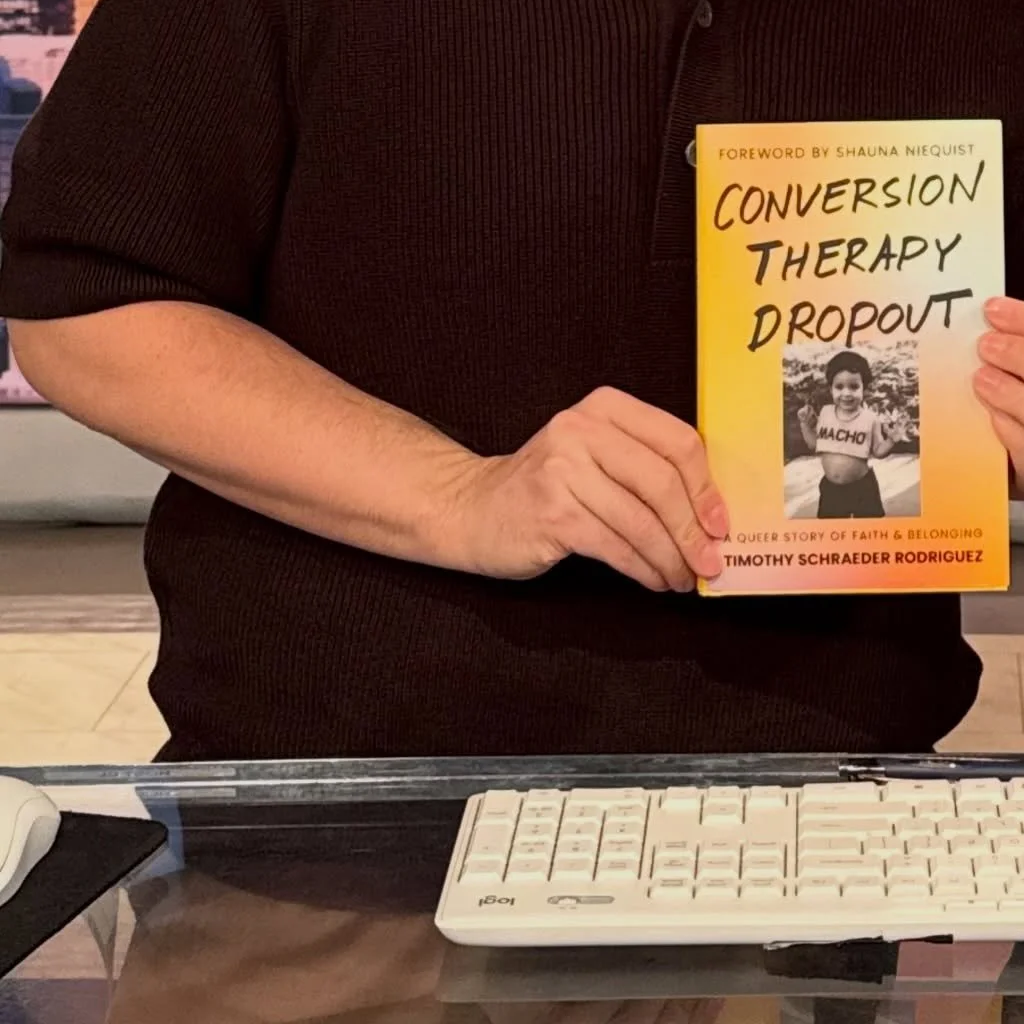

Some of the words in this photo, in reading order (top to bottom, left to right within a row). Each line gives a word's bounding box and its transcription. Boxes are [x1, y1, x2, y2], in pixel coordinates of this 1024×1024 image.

[718, 147, 805, 161] FOREWORD
[811, 146, 830, 159] BY
[835, 145, 899, 158] SHAUNA
[905, 144, 975, 158] NIEQUIST
[713, 159, 985, 231] CONVERSION
[746, 233, 962, 286] THERAPY
[747, 288, 974, 353] DROPOUT
[819, 425, 867, 445] MACHO
[723, 532, 732, 543] A
[736, 531, 779, 544] QUEER
[783, 531, 825, 543] STORY
[829, 530, 847, 542] OF
[851, 529, 889, 541] FAITH
[893, 529, 903, 541] &
[907, 527, 984, 541] BELONGING
[723, 553, 794, 568] TIMOTHY
[797, 551, 891, 567] SCHRAEDER
[894, 549, 984, 565] RODRIGUEZ
[477, 894, 516, 908] logi
